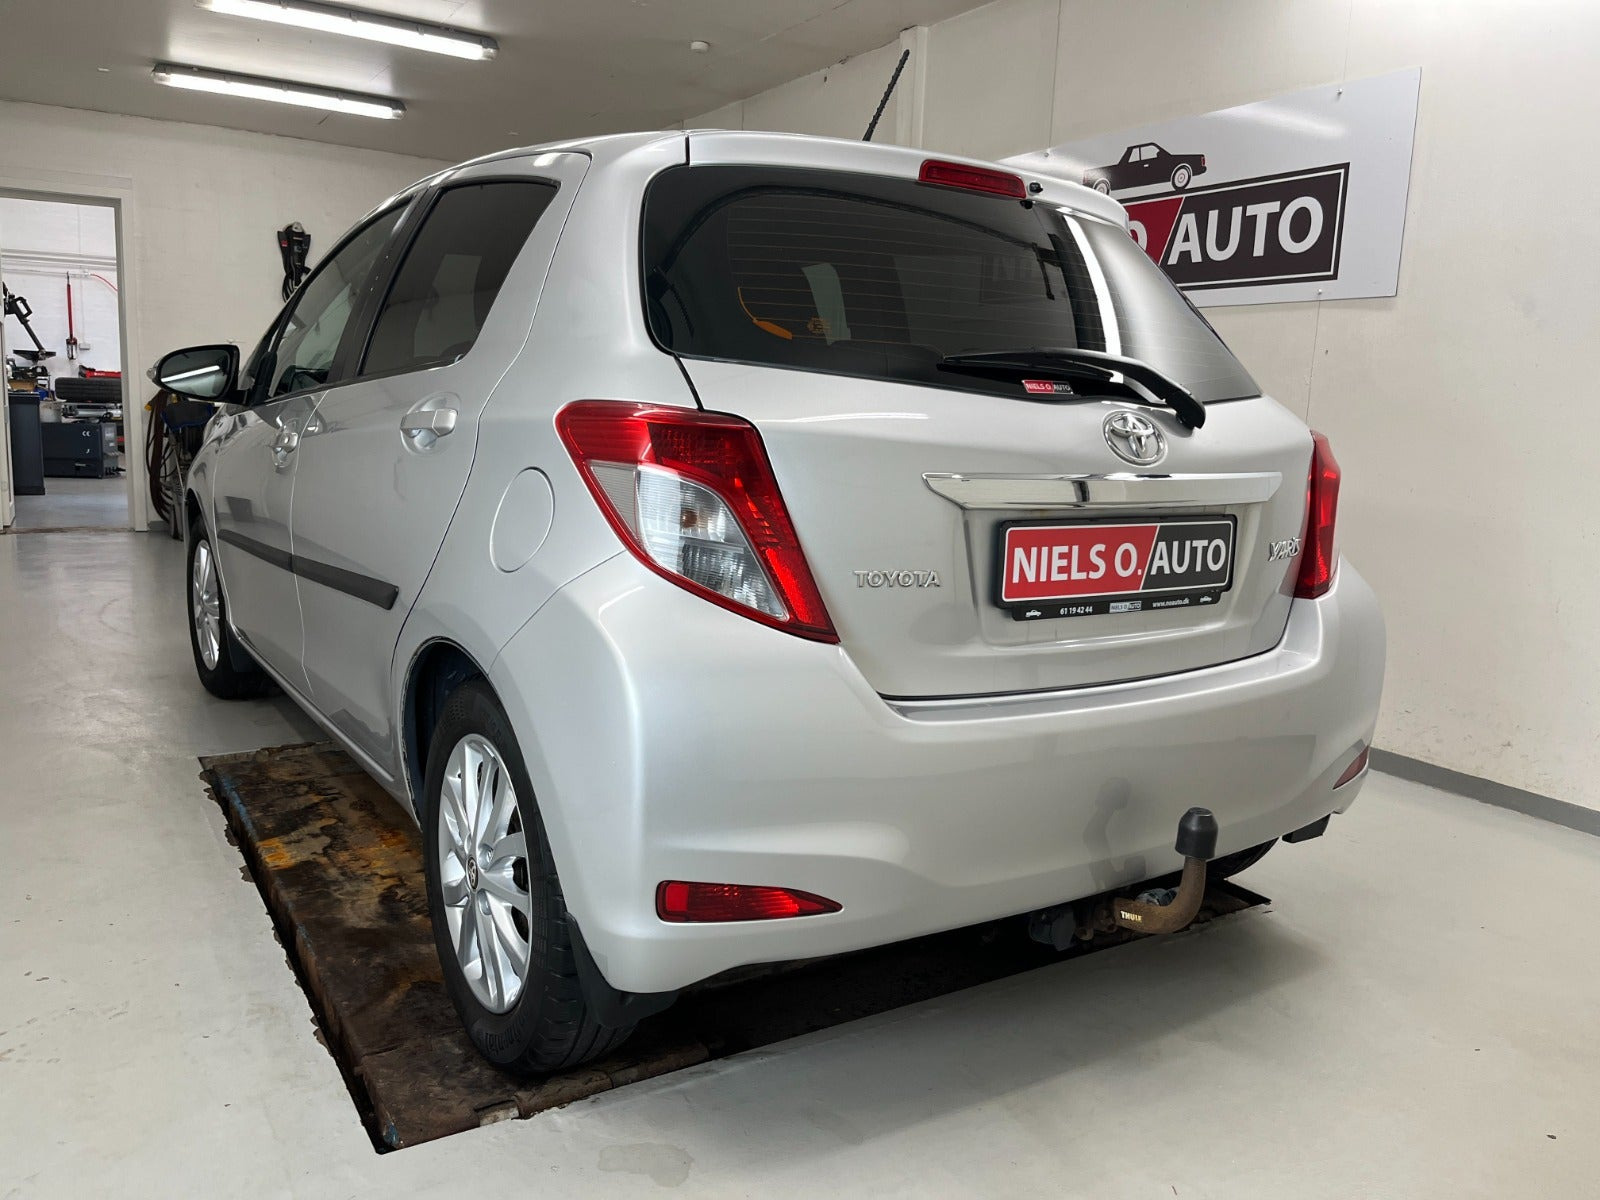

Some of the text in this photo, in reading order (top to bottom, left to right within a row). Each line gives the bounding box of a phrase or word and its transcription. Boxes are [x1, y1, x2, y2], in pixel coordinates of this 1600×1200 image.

[1167, 196, 1324, 265] AUTO
[1012, 538, 1226, 584] NIELS O. AUTO
[854, 570, 940, 588] TOYOTA
[1060, 605, 1093, 615] 61 19 42 44
[1152, 597, 1190, 608] www.noauto.dk
